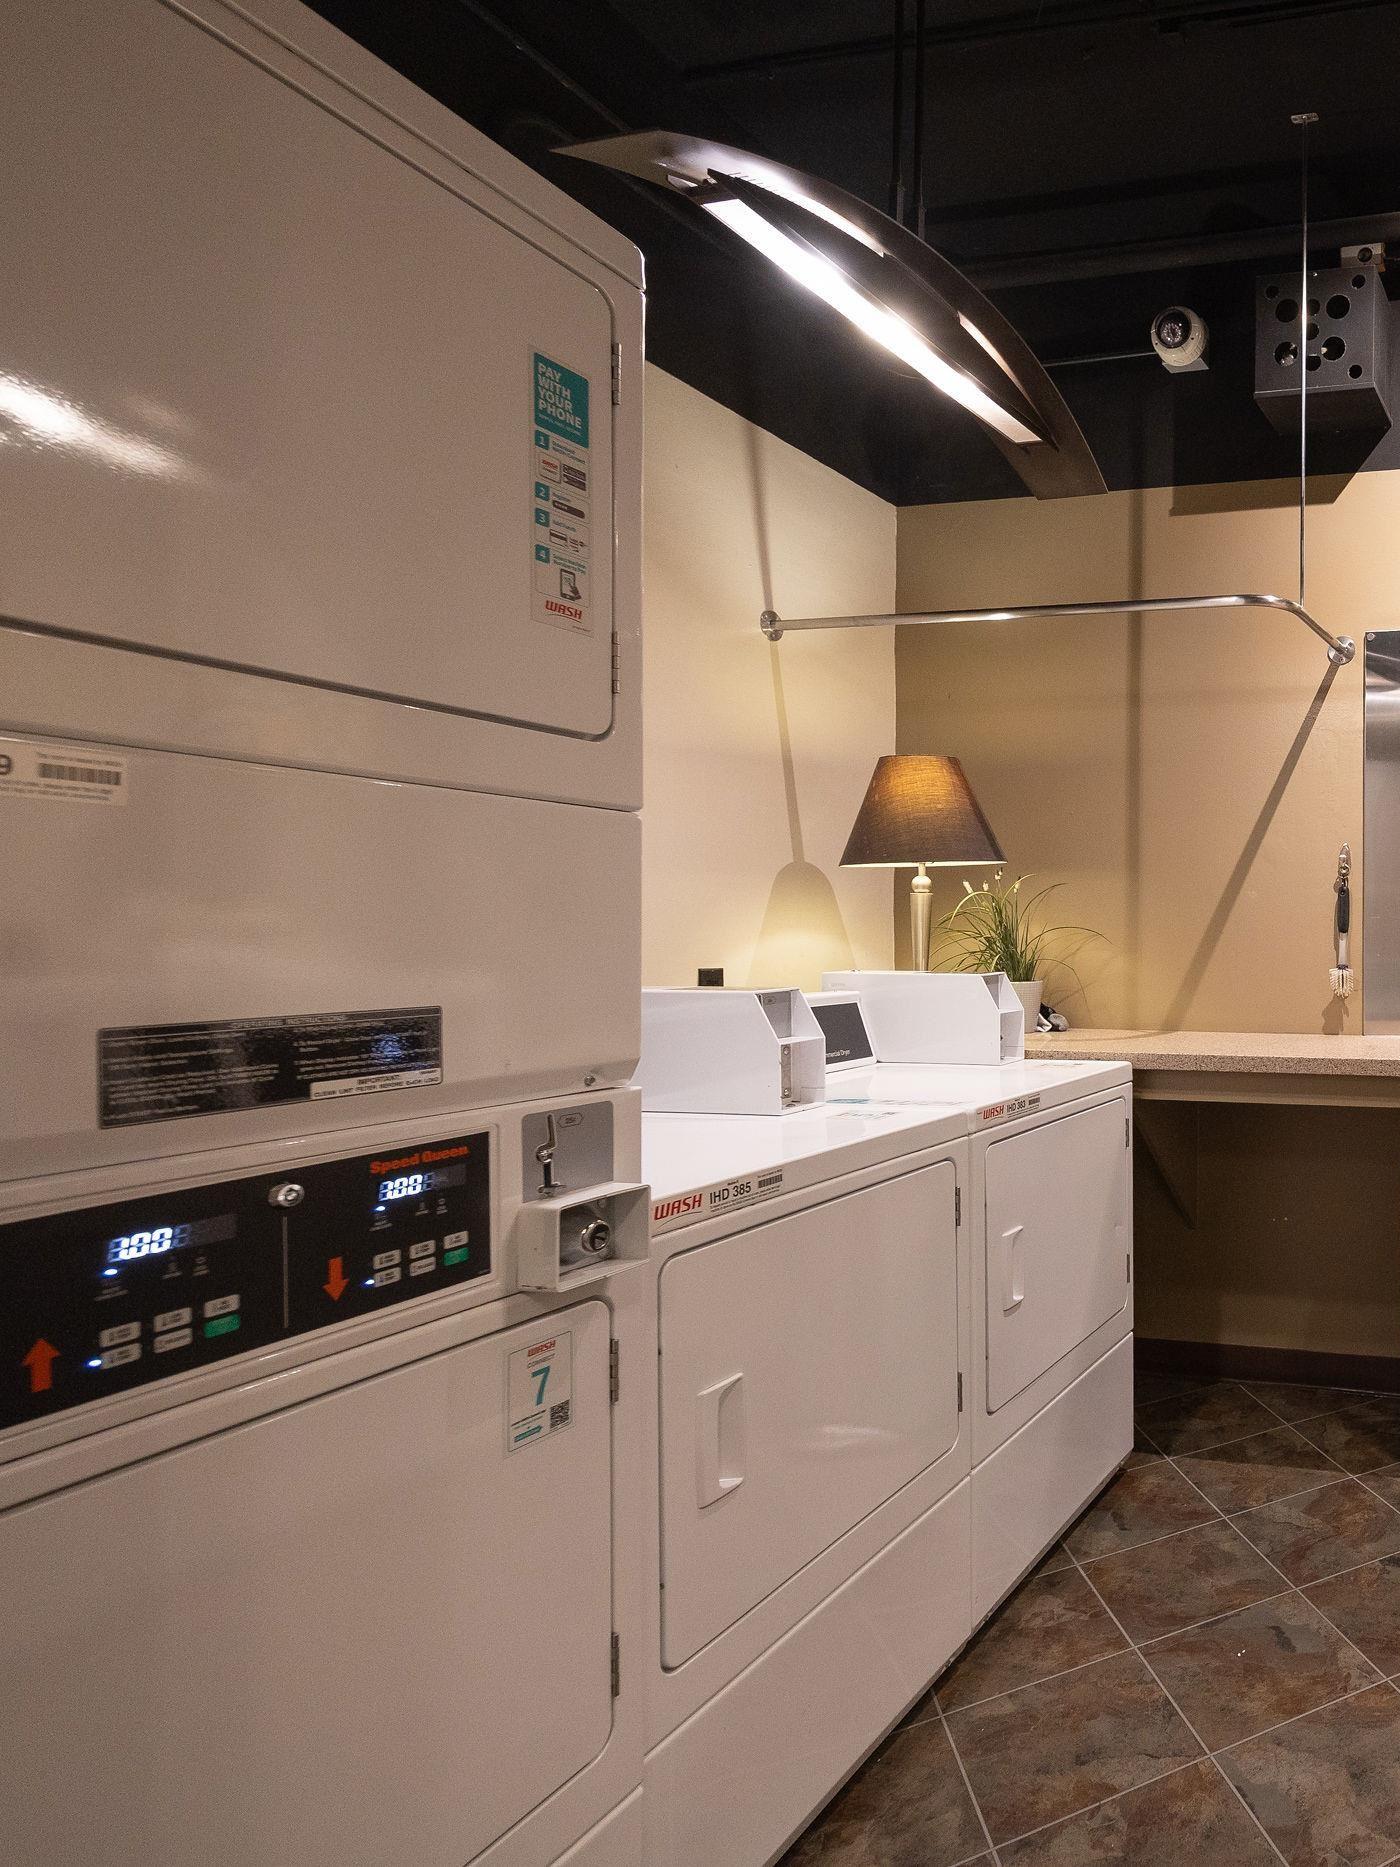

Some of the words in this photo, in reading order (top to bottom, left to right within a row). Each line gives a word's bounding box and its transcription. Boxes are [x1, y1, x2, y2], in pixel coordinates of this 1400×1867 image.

[538, 362, 561, 382] PAY
[538, 374, 571, 400] WITH
[538, 386, 573, 414] YOUR
[538, 398, 582, 429] PHONE
[539, 487, 547, 498] 2
[539, 512, 547, 523] 3
[545, 600, 583, 620] WASH
[983, 1105, 1005, 1120] WASH
[370, 1153, 420, 1175] Speed
[421, 1146, 470, 1164] Queen
[654, 1193, 703, 1221] WASH
[709, 1188, 730, 1205] IHD
[732, 1182, 752, 1198] 385
[527, 1339, 556, 1358] WASH
[531, 1365, 551, 1406] 7
